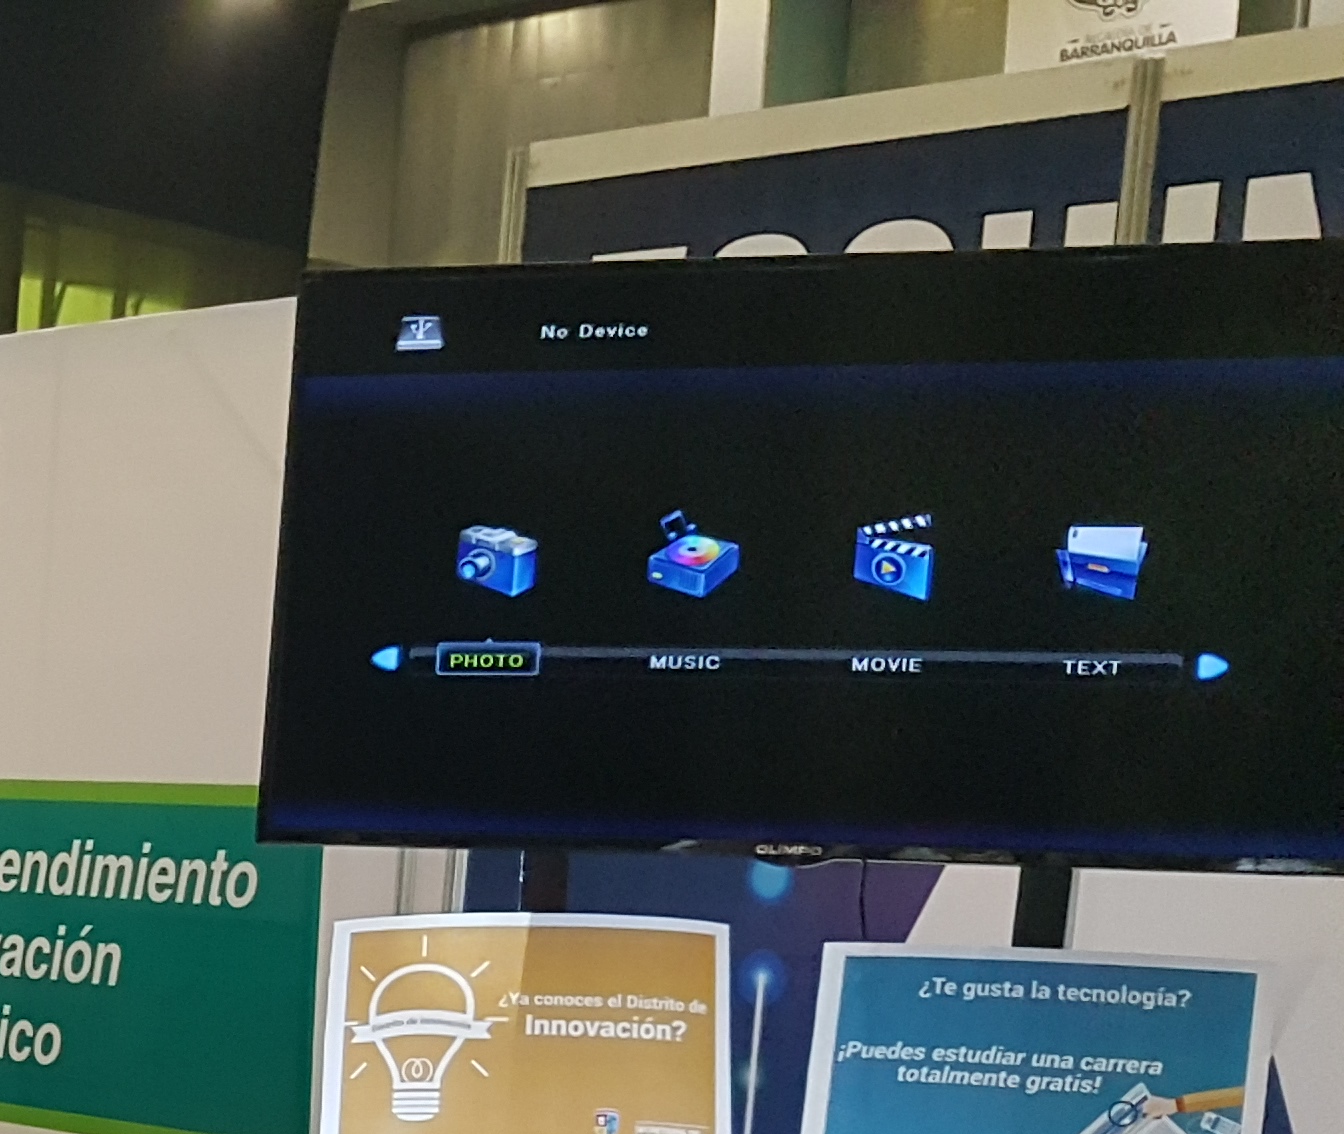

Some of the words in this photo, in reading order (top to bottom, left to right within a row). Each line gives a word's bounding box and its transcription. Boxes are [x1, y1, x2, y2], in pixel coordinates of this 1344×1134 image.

[1060, 31, 1177, 62] BARRANQUILLA
[540, 325, 568, 339] No
[579, 323, 648, 338] Device
[450, 654, 524, 668] PHOTO
[650, 655, 720, 670] MUSIC
[852, 657, 923, 673] MOVIE
[1064, 660, 1121, 676] TEXT
[499, 992, 529, 1008] ¿Ya
[534, 994, 604, 1008] conoces
[607, 994, 623, 1008] el
[627, 995, 686, 1012] Distrito
[689, 998, 708, 1014] de
[919, 977, 958, 998] ¿Te
[963, 980, 1024, 1000] gusta
[1031, 980, 1051, 999] la
[1058, 983, 1193, 1010] tecnología?
[525, 1014, 688, 1042] Innovación?
[837, 1041, 926, 1062] ¡Puedes
[932, 1045, 1027, 1066] estudiar
[1031, 1052, 1074, 1069] una
[1080, 1057, 1164, 1075] carrera
[897, 1066, 1020, 1088] totalmente
